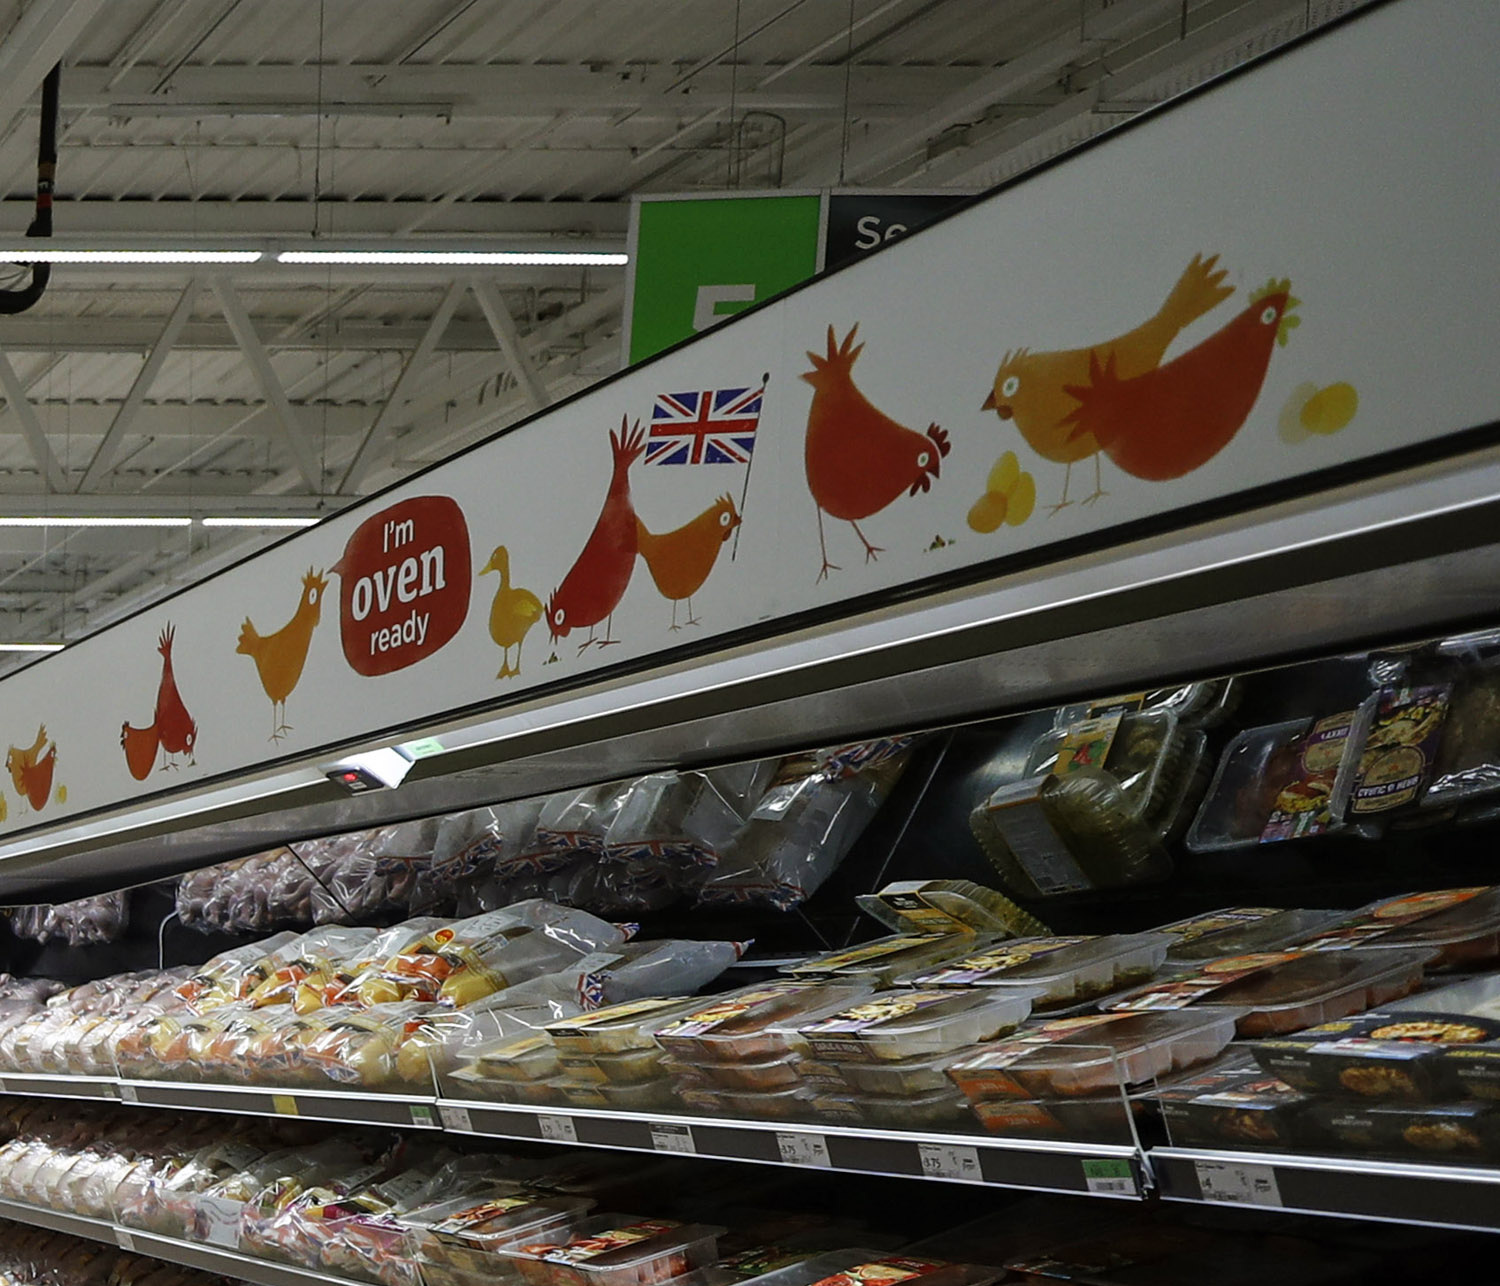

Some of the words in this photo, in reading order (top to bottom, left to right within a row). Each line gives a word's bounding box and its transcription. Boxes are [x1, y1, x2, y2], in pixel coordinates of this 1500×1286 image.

[384, 519, 414, 553] I'm
[351, 545, 446, 621] oven
[370, 609, 430, 656] ready
